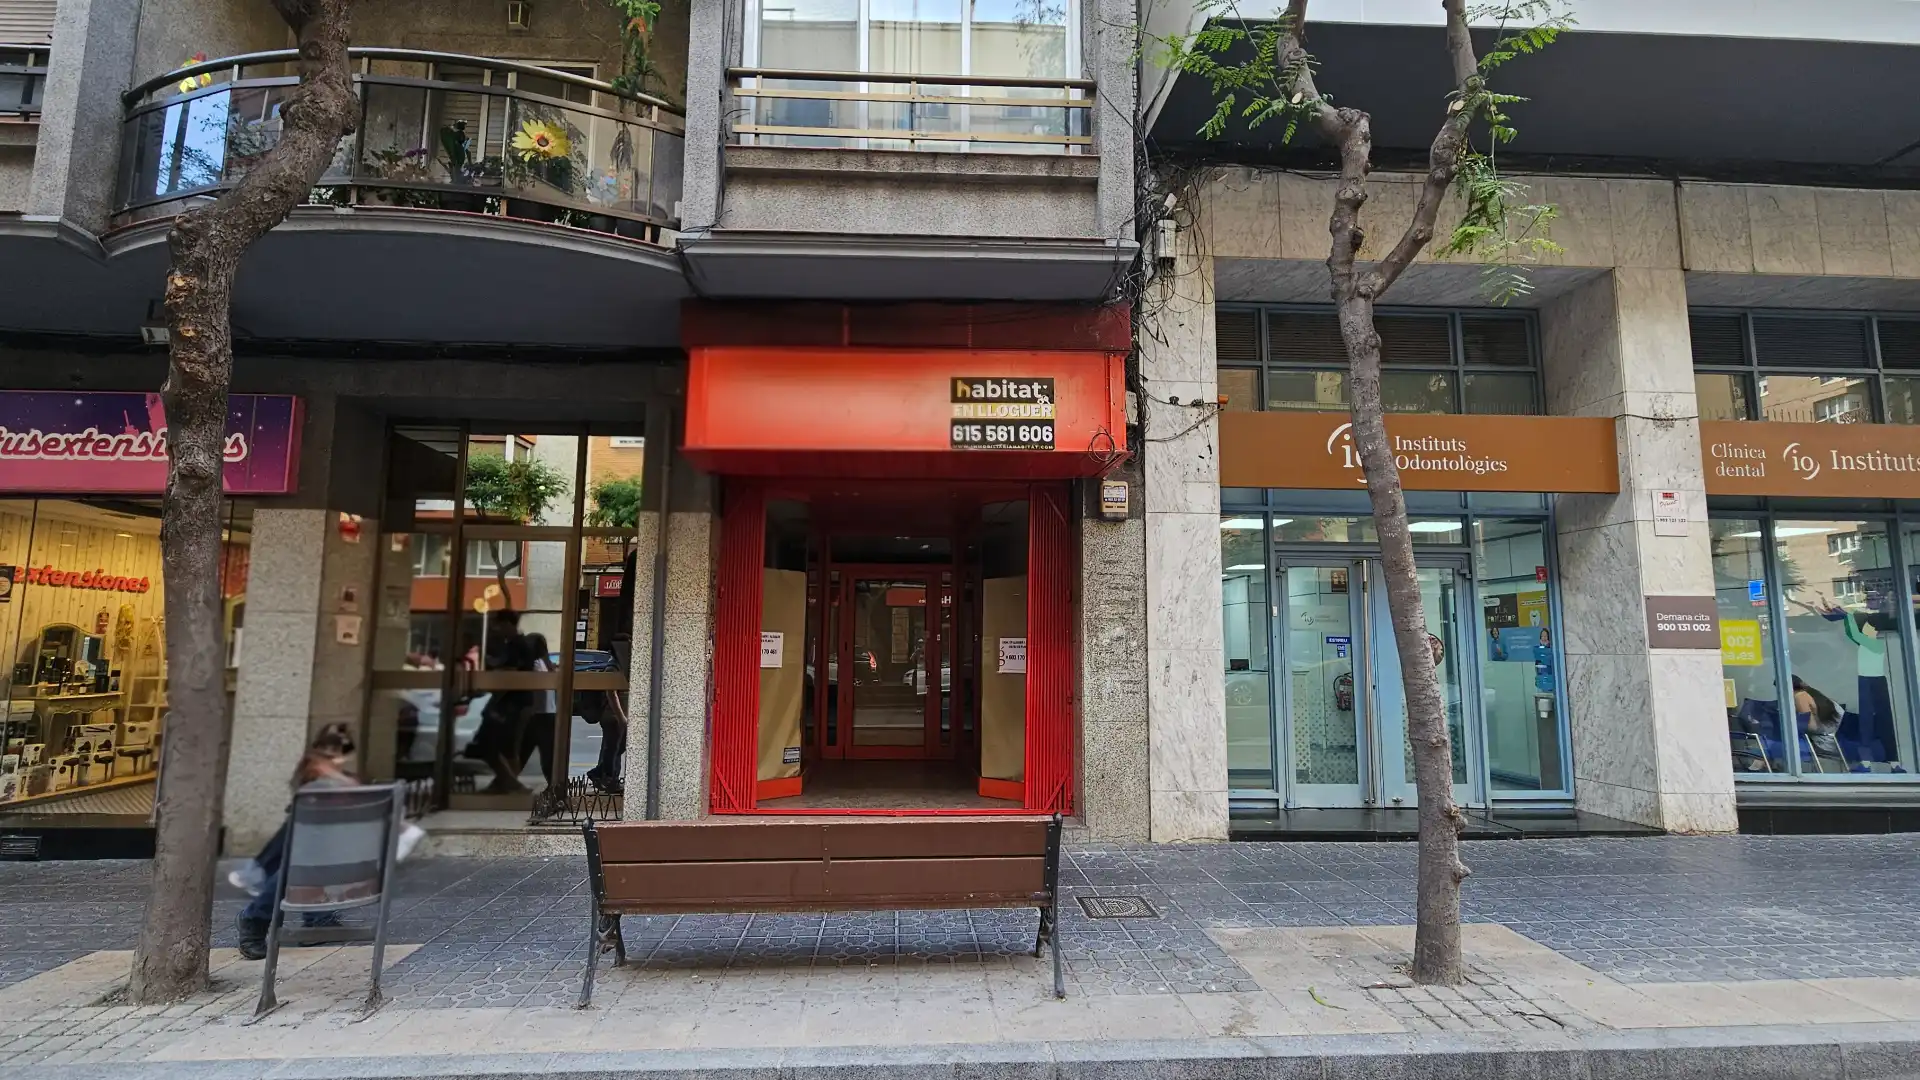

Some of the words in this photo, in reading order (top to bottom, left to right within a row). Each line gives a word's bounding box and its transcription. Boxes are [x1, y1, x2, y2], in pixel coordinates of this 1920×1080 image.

[956, 379, 1042, 398] habitat
[952, 404, 974, 418] EN
[976, 404, 1053, 418] LLOGUER
[952, 425, 982, 442] 615
[985, 425, 1015, 442] 561
[1018, 425, 1053, 442] 606
[0, 427, 248, 461] usextensis
[1395, 435, 1467, 452] Instituts
[1711, 443, 1767, 459] Clínica
[1395, 454, 1508, 475] Odontològics
[1830, 449, 1920, 472] Instituts
[1715, 462, 1766, 477] dental
[14, 565, 150, 593] extensiones
[1656, 612, 1693, 621] Demana
[1694, 612, 1710, 621] cita
[1657, 623, 1676, 631] 900
[1677, 623, 1691, 631] 131
[1692, 623, 1711, 631] 002
